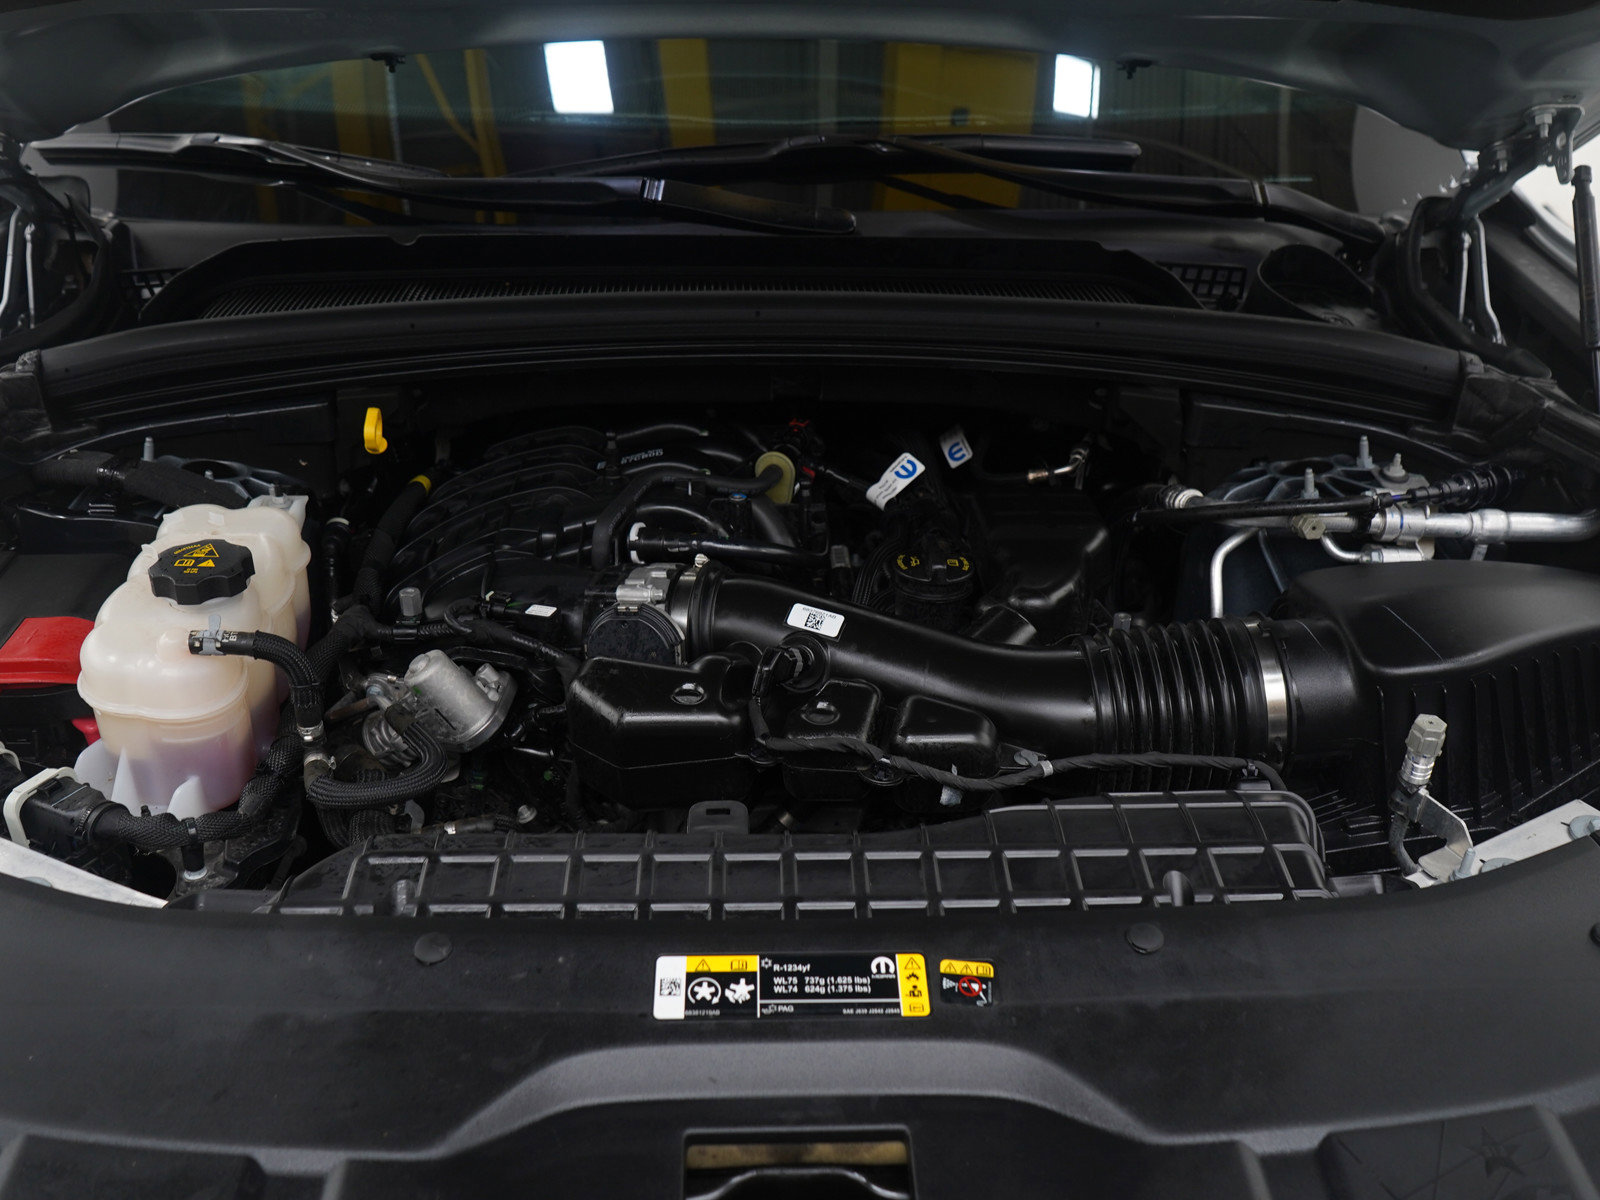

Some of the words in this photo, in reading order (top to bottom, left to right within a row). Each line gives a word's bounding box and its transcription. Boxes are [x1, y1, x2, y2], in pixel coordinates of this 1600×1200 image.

[773, 963, 811, 974] R-1234yf
[804, 976, 825, 986] 737g
[854, 976, 871, 986] lbs)
[773, 985, 798, 994] WL74
[804, 985, 826, 995] 624g
[855, 984, 872, 994] lbs)
[778, 1005, 794, 1013] PAG
